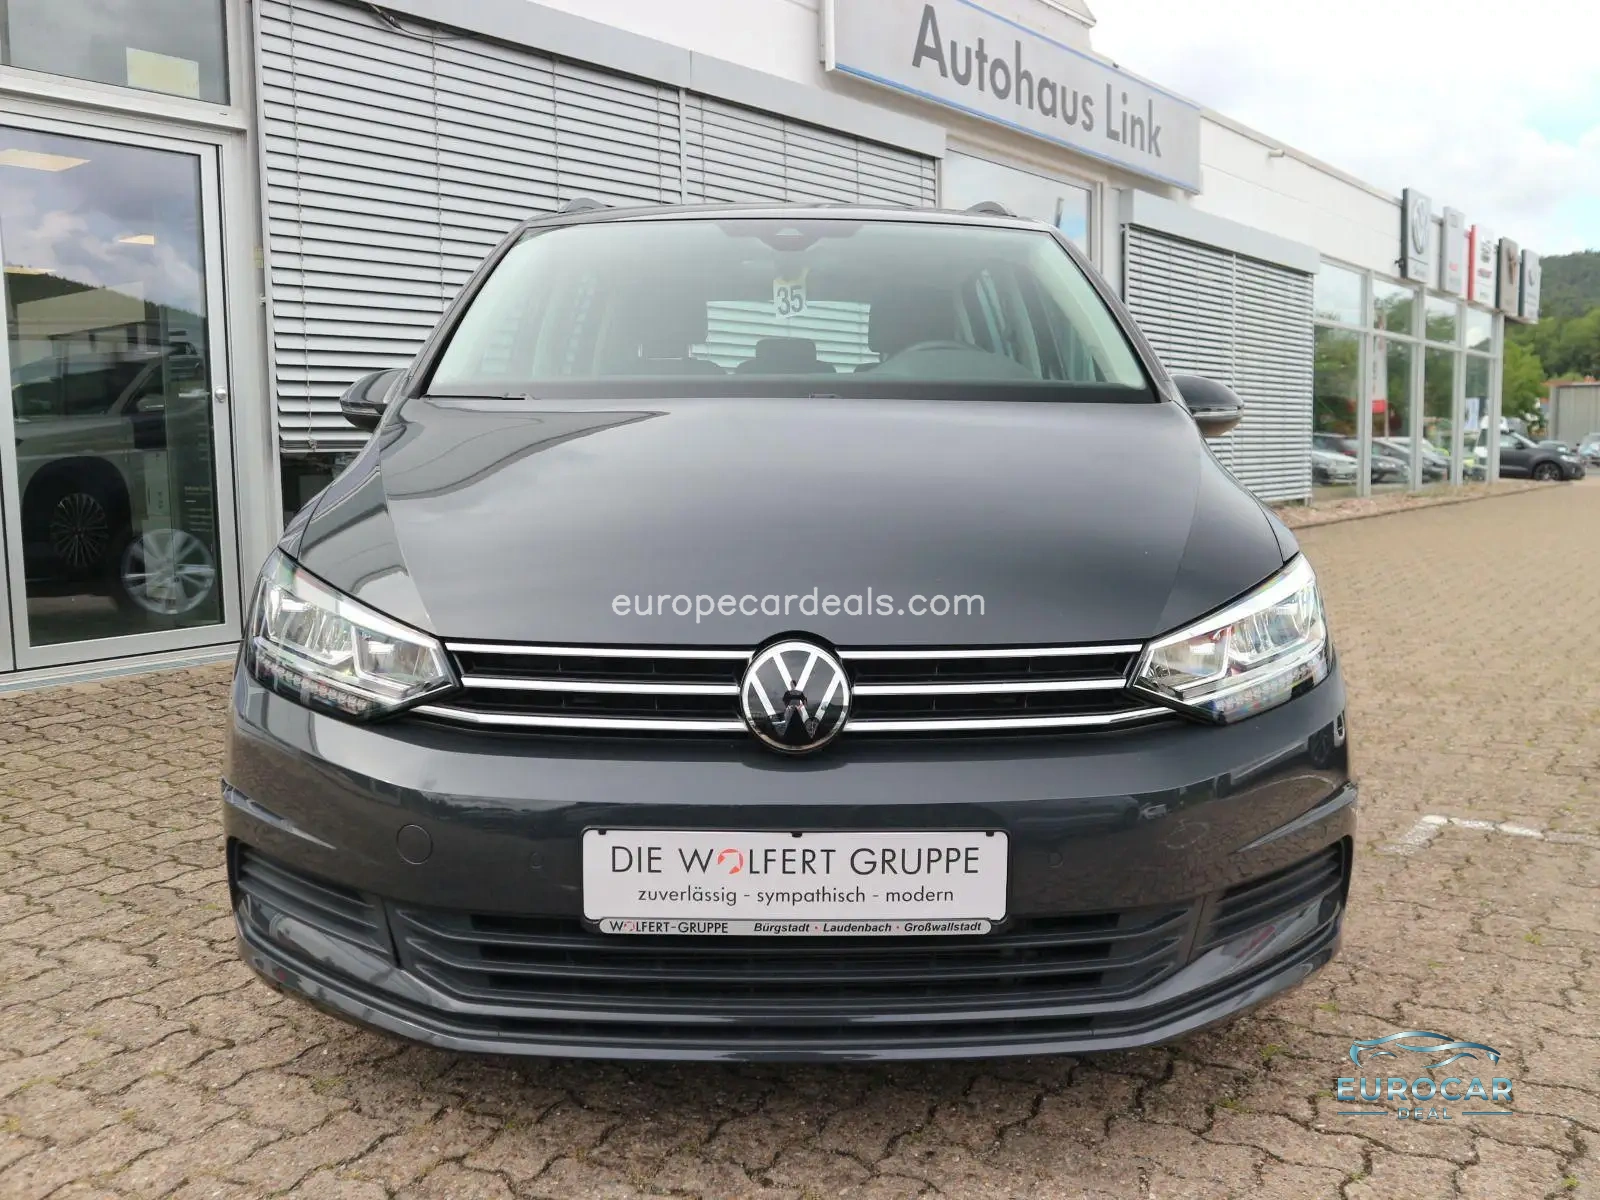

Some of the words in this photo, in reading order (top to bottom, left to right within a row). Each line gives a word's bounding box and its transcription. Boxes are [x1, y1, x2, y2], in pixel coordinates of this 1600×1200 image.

[912, 3, 1094, 132] Autohaus
[1106, 82, 1162, 158] Link
[777, 284, 804, 316] 35
[611, 845, 663, 874] DIE
[850, 846, 980, 876] GRUPPE
[638, 885, 737, 907] zuverlässig
[757, 885, 866, 907] sympathisch
[886, 885, 955, 903] modern
[823, 921, 893, 933] Laudenbach
[904, 921, 982, 933] Großwallstadt
